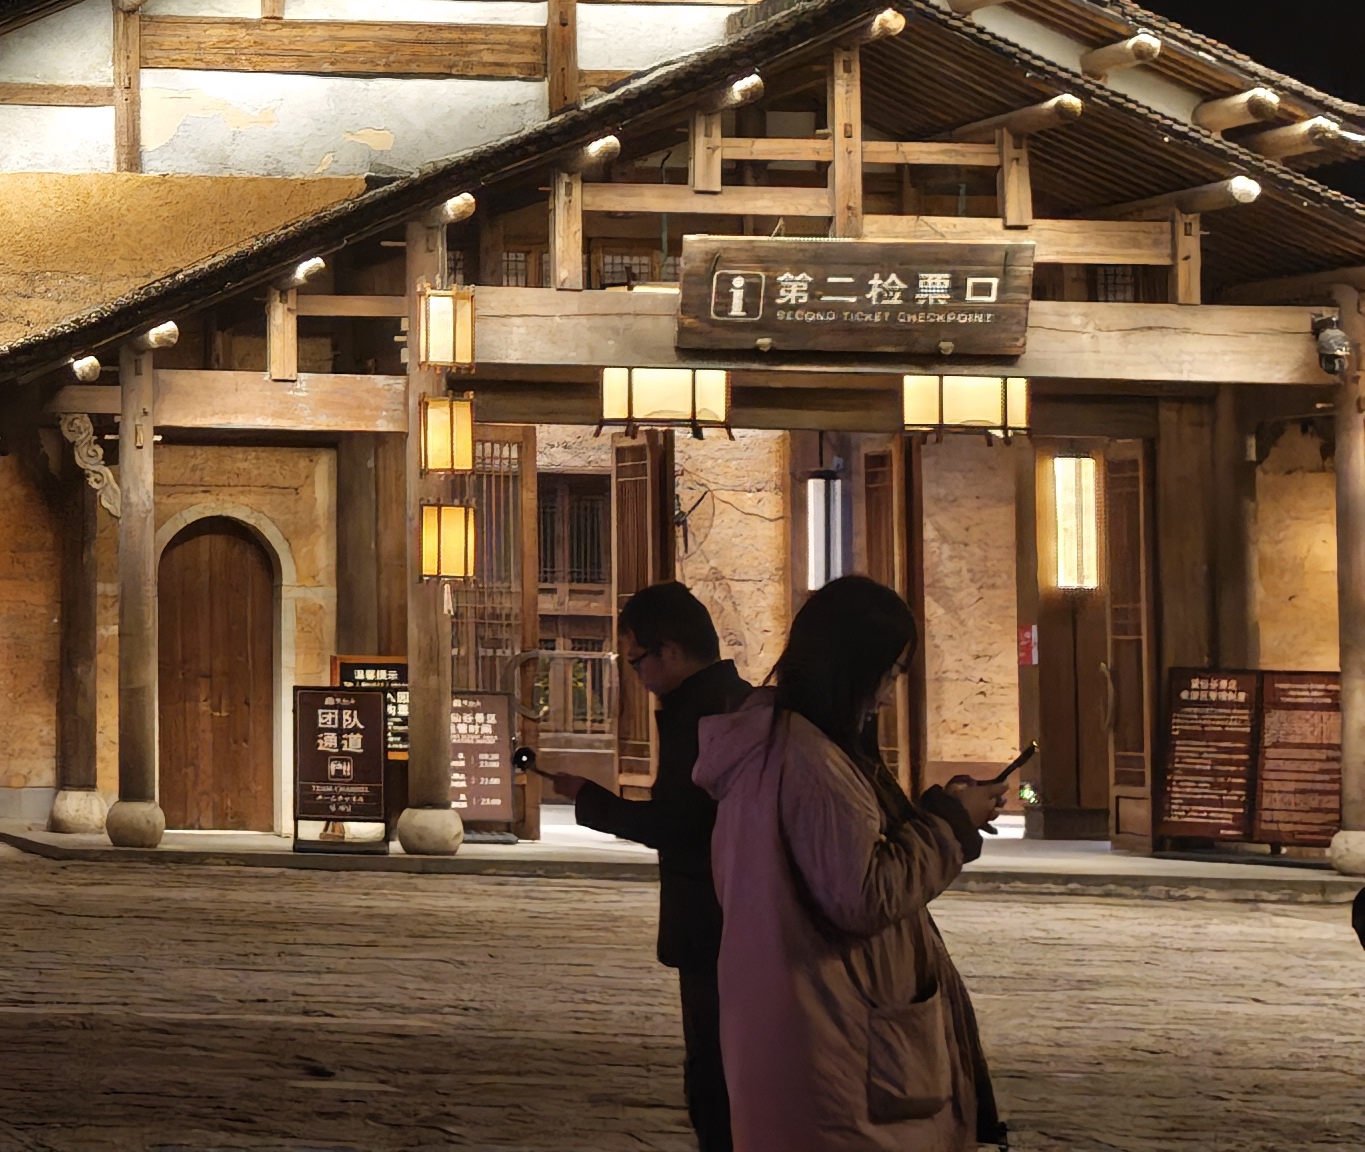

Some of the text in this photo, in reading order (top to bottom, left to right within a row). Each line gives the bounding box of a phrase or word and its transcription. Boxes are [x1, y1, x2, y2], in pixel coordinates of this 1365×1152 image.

[775, 272, 1000, 306] 第二检票口
[776, 310, 994, 324] SECOND TICKET CHECKPOINT
[317, 709, 365, 729] 团队
[316, 732, 365, 753] 通道
